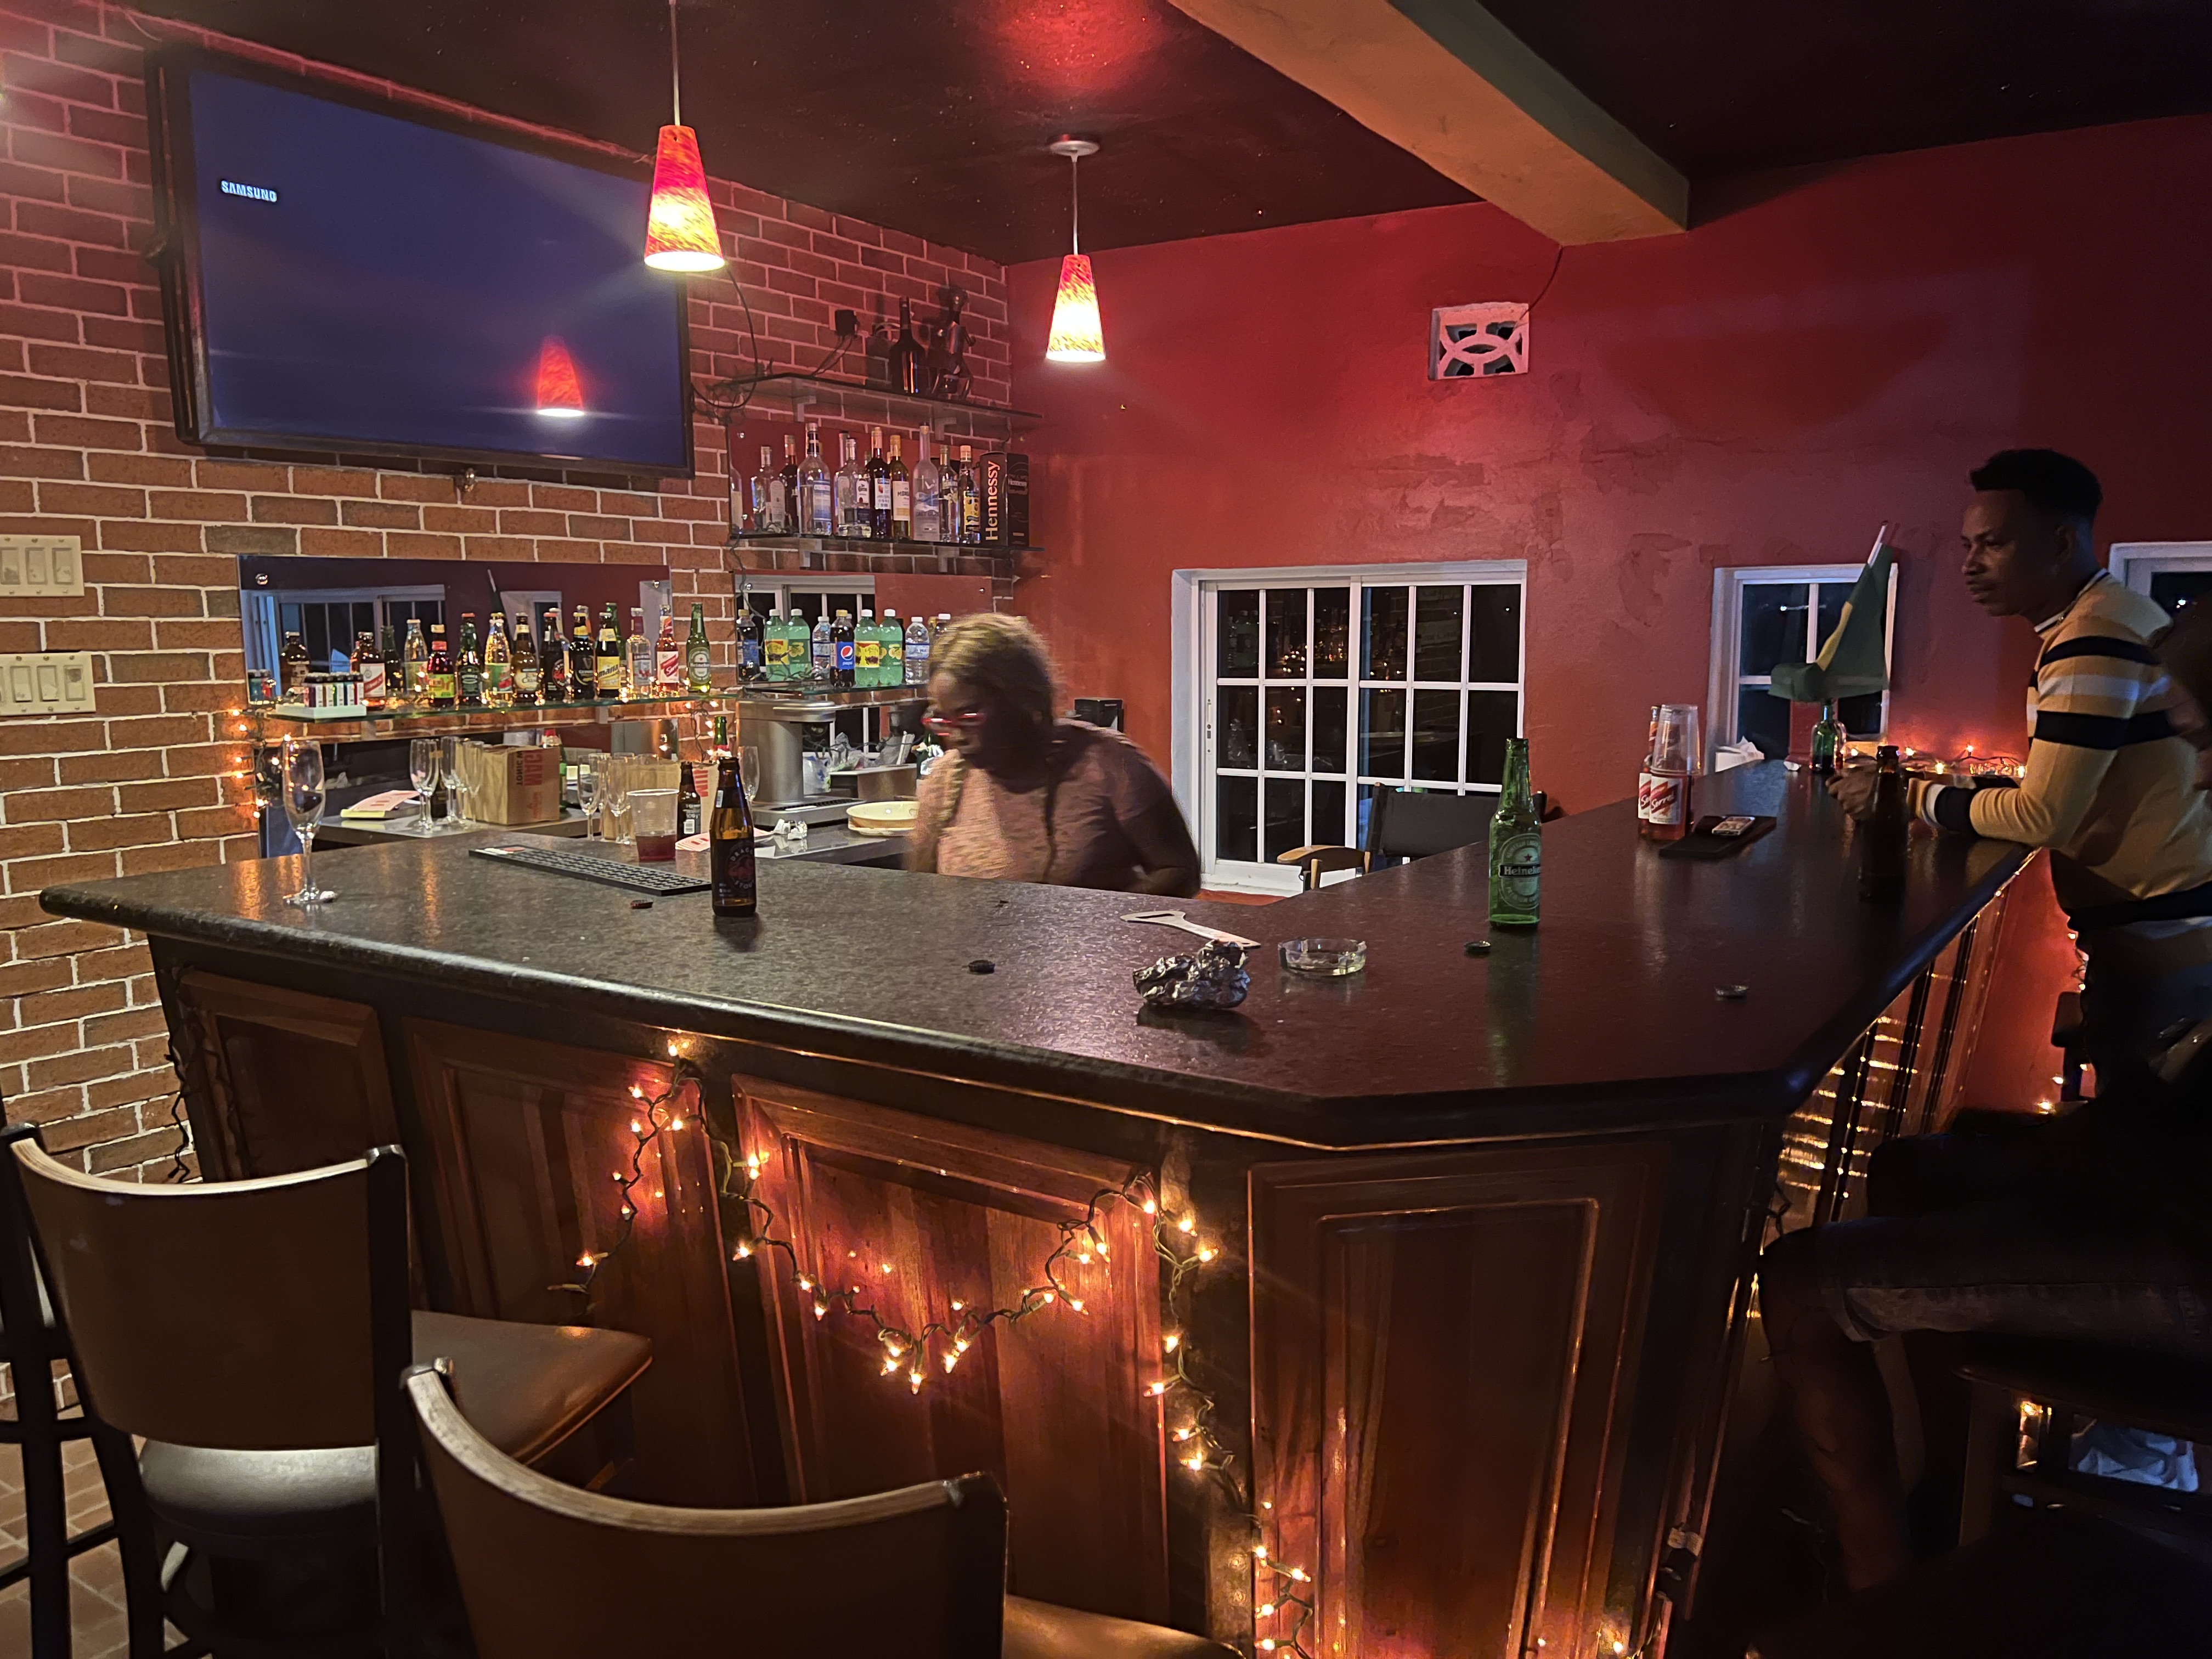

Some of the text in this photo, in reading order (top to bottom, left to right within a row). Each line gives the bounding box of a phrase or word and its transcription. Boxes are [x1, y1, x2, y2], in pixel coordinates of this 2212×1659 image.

[221, 180, 277, 202] SAMSUNG
[985, 461, 1000, 540] Hennessy
[599, 664, 618, 678] malta
